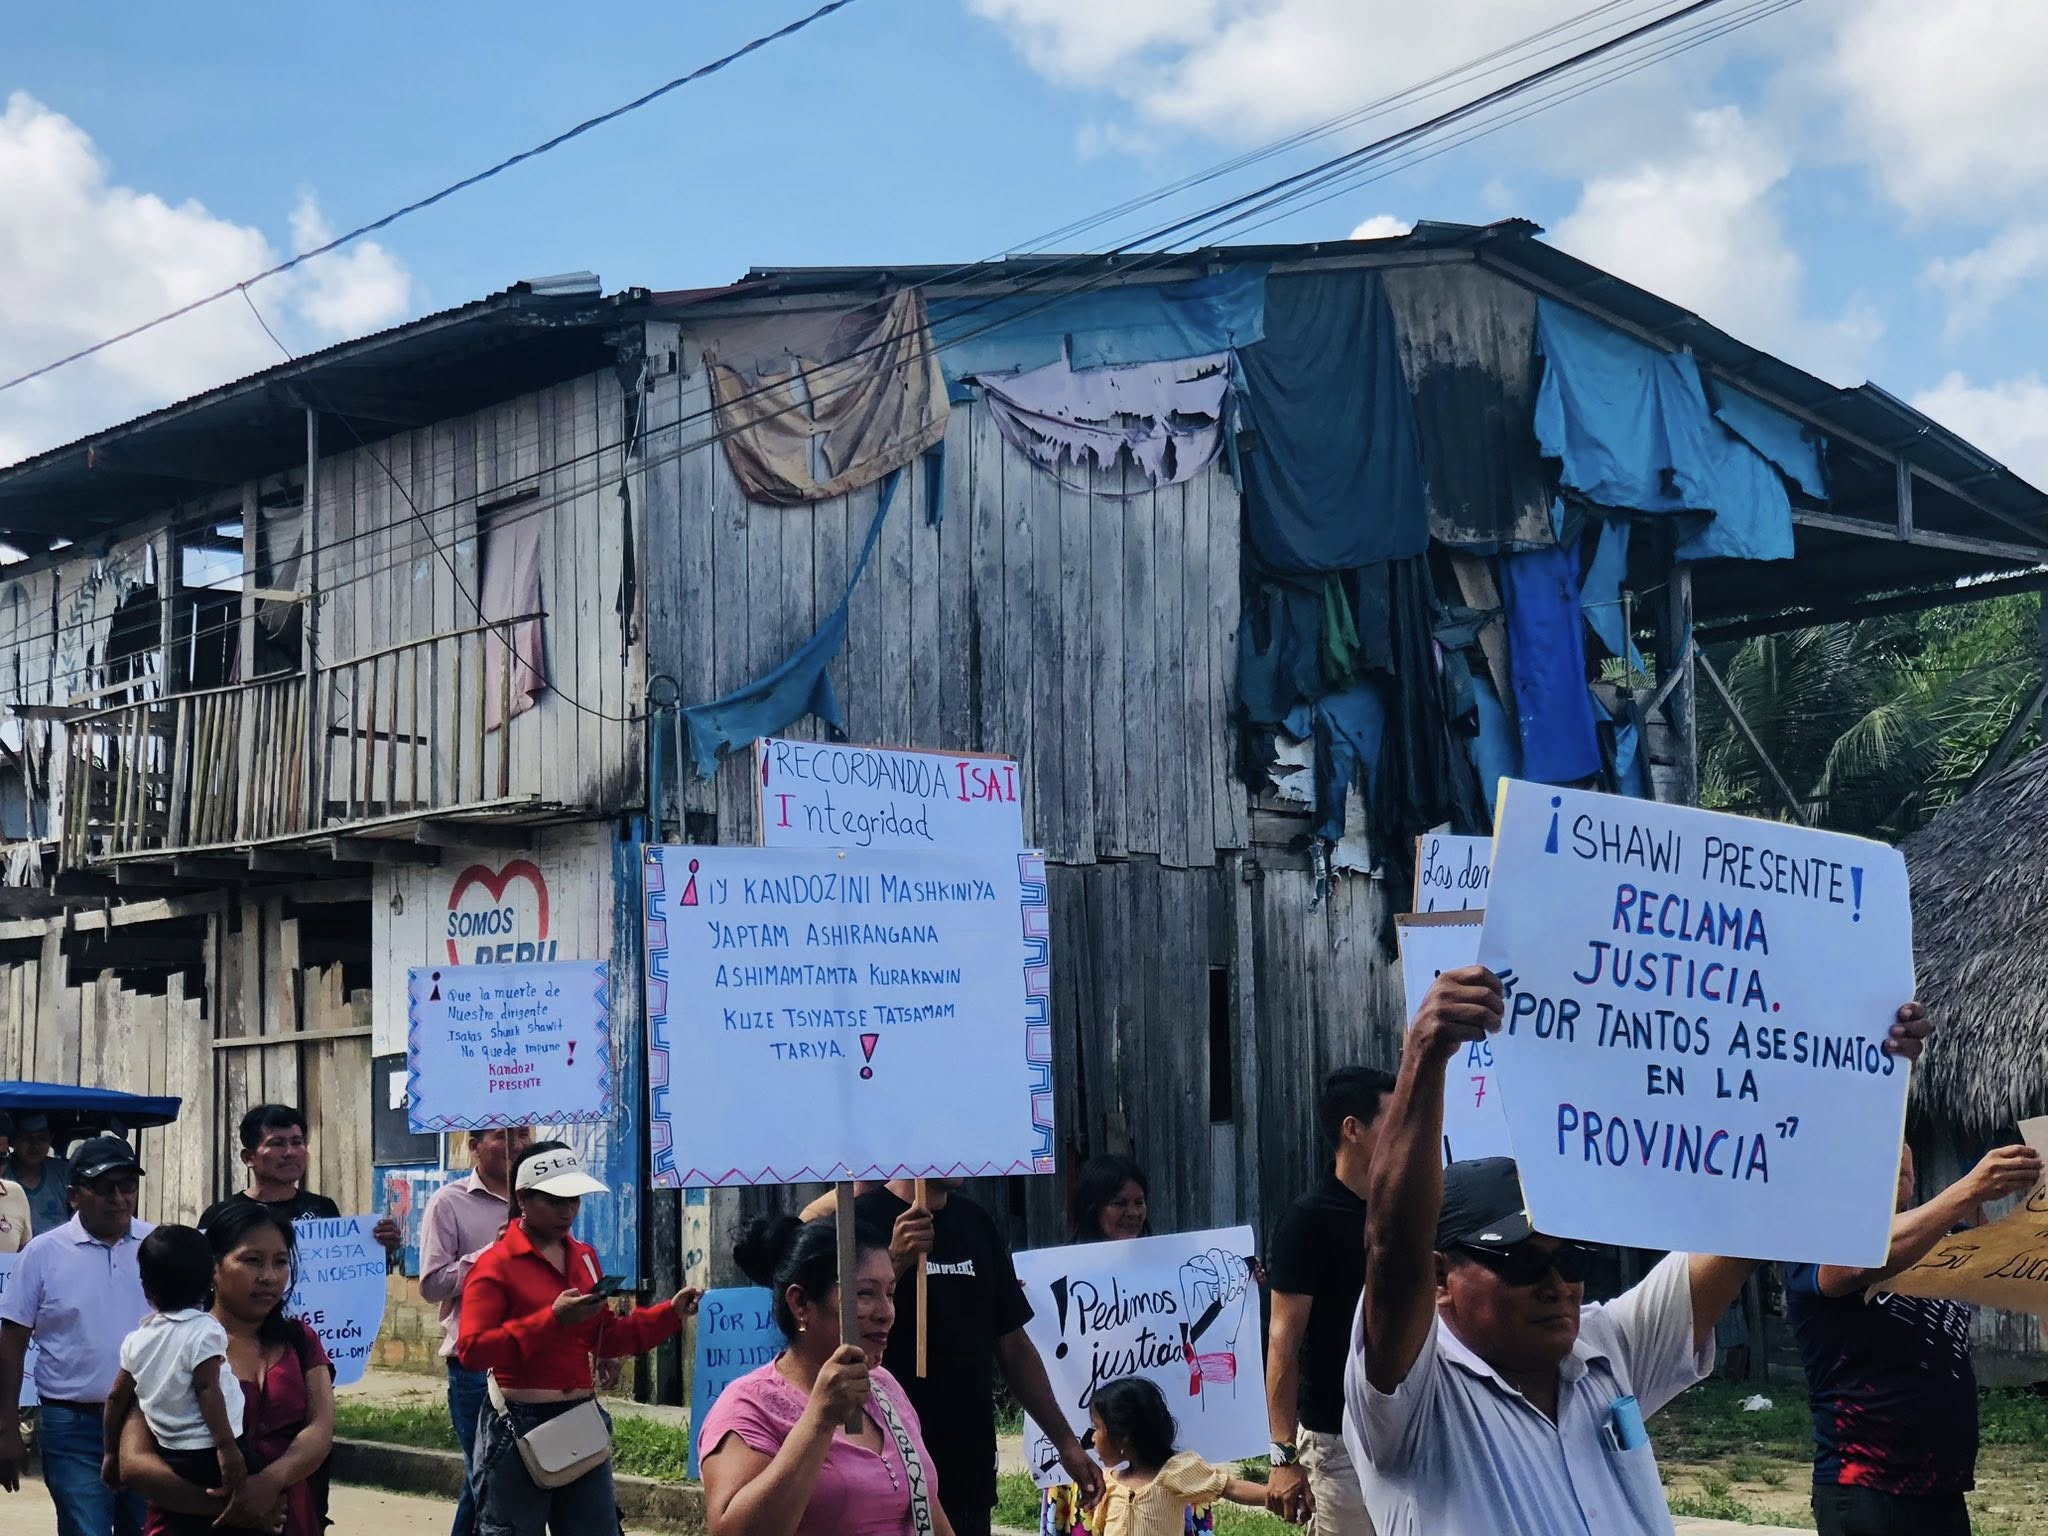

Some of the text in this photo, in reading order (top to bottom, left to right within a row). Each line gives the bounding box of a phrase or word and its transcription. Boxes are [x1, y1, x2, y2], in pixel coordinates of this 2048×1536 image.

[956, 762, 1016, 803] ISAI
[1544, 796, 1863, 922] ¡SHAWI PRESENTE!
[744, 874, 870, 904] KANDOZINI
[881, 874, 996, 902] MASHKINIYA
[447, 907, 514, 937] SOMOS
[1612, 883, 1769, 955] RECLAMA
[708, 921, 938, 948] YAPTAM ASHIRANGANA
[715, 963, 961, 987] ASHIMAMTAMTA KURAKAWIN
[1573, 940, 1780, 1013] JUSTICIA.
[479, 986, 490, 1001] la
[495, 981, 537, 999] muerte
[545, 980, 560, 997] de
[448, 1000, 548, 1021] Nuestro dirigente
[724, 1004, 955, 1030] KUZE TSIYATSE TATSAMAM
[461, 1045, 474, 1057] No
[1597, 1002, 1710, 1056] TANTOS
[1728, 1020, 1895, 1077] ASESINATOS
[490, 1078, 541, 1093] PRESENTE
[1470, 1076, 1485, 1108] 7
[1646, 1064, 1758, 1102] EN LA
[318, 1261, 385, 1283] NUESTRO
[706, 1347, 731, 1367] UN
